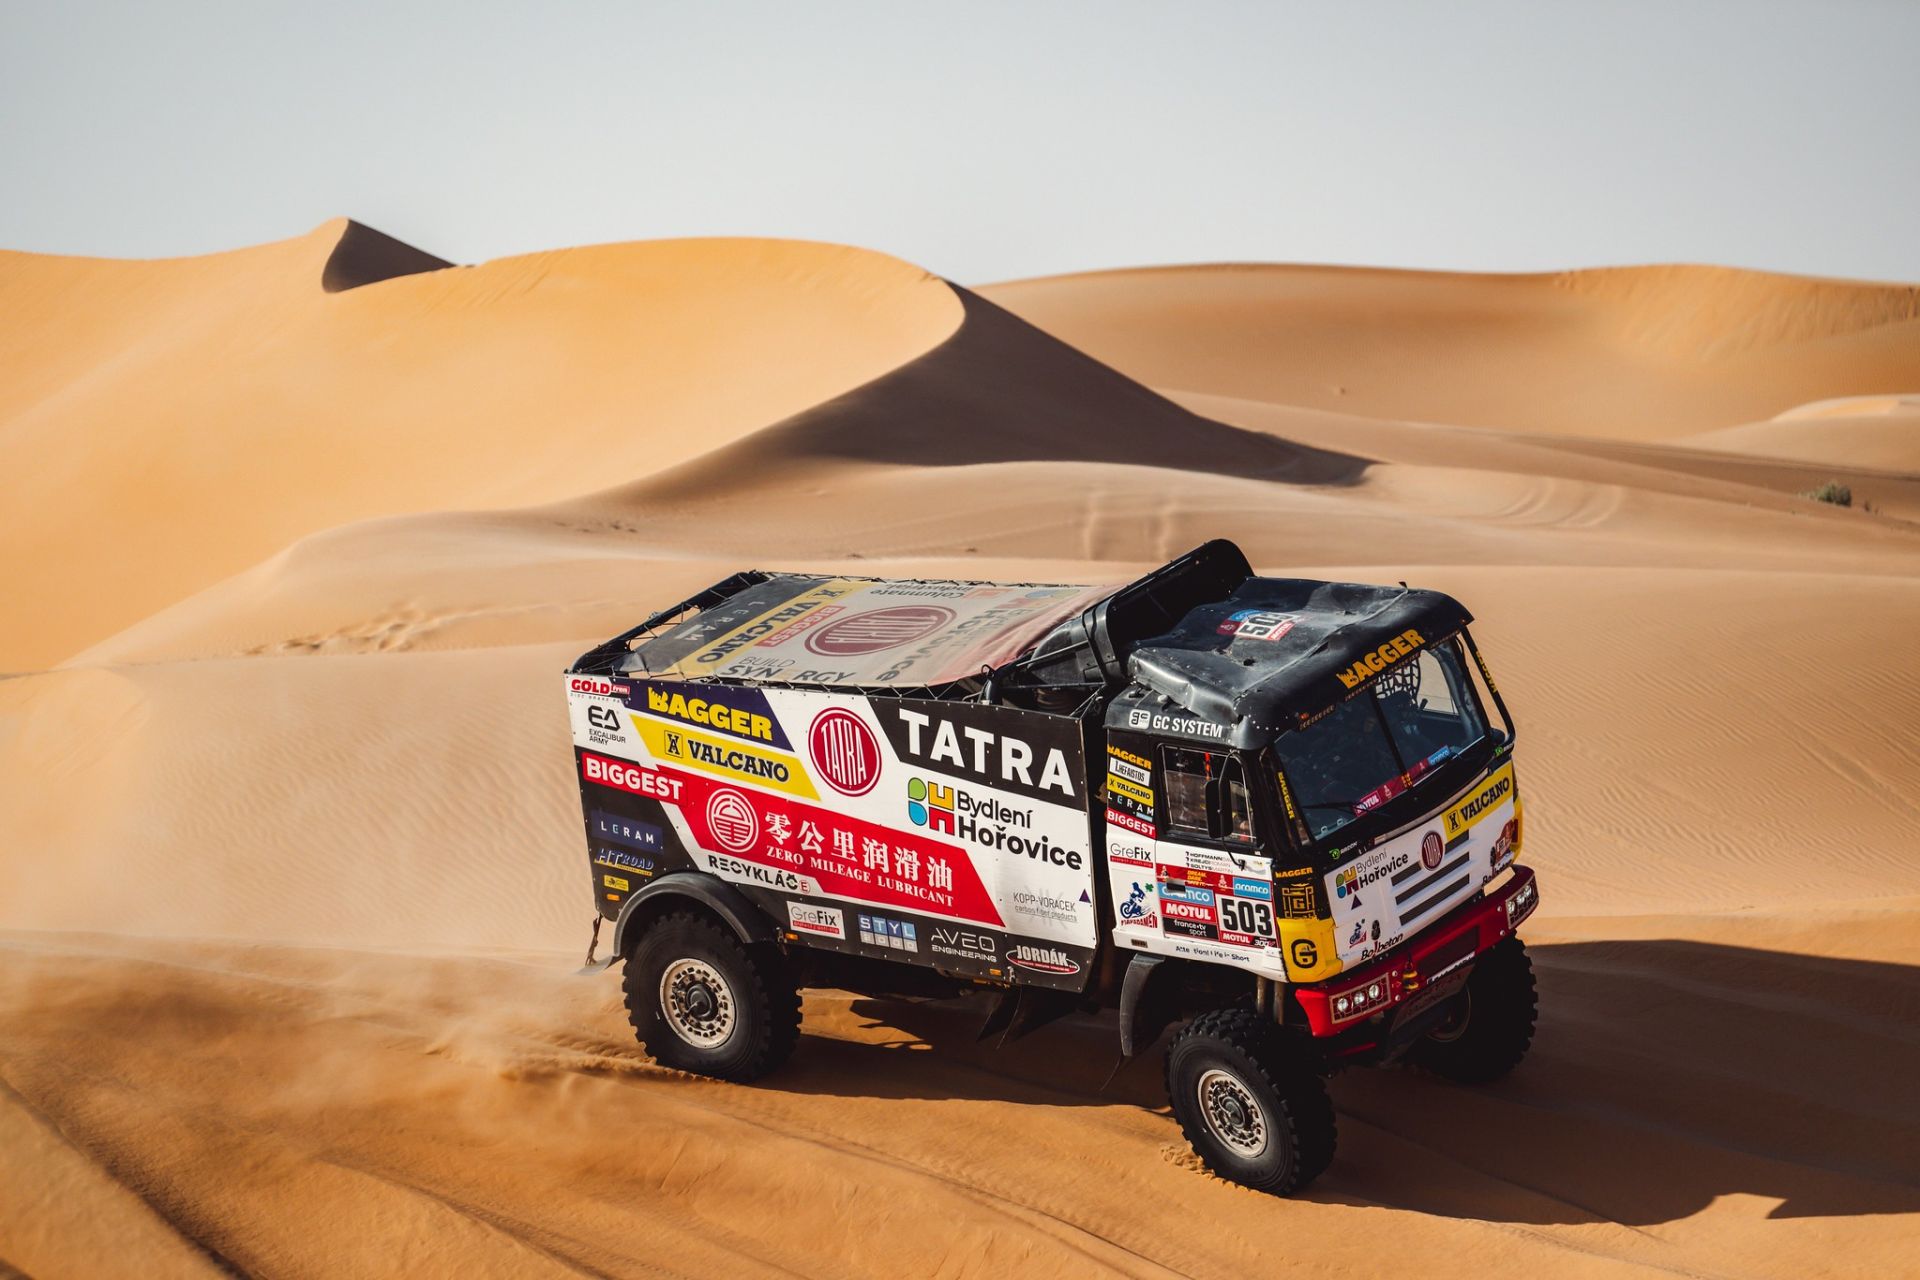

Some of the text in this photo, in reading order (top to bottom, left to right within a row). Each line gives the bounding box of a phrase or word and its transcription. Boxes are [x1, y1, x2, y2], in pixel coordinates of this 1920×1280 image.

[697, 601, 822, 663] VALCANO
[760, 606, 841, 645] BIGGEST
[739, 656, 796, 668] BUILD
[1336, 629, 1426, 689] BAGGER
[721, 664, 856, 683] SYNRGY
[571, 679, 610, 695] GOLD
[648, 687, 772, 741] BAGGER
[1152, 714, 1223, 738] GC SYSTEM
[589, 729, 626, 743] EXCALIBUR
[589, 736, 609, 746] ARMY
[688, 739, 790, 783] VALCANO
[820, 718, 868, 786] TATRA
[899, 707, 1076, 797] TATRA
[1107, 744, 1152, 770] BAGGER
[586, 757, 684, 800] BIGGEST
[1117, 782, 1151, 800] VALCANO
[957, 789, 1033, 829] Bydlení
[1107, 791, 1154, 817] LERAM
[1460, 777, 1510, 822] VALCANO
[601, 821, 654, 844] LERAM
[1107, 810, 1155, 836] BIGGEST
[765, 812, 954, 892] 零公里润滑油
[959, 815, 1082, 871] Hořovice
[1110, 843, 1151, 861] GreFix
[1275, 867, 1313, 879] BAGGER
[1356, 847, 1388, 874] Bydlení
[1358, 853, 1409, 890] Hořovice
[766, 845, 955, 907] ZERO MILEAGE LUBRICANT
[1234, 881, 1269, 895] aramco
[1161, 886, 1211, 902] amco
[790, 906, 838, 927] GreFix
[1166, 902, 1212, 921] MOTUL
[1221, 898, 1273, 936] 503
[860, 917, 914, 938] STYL
[931, 927, 996, 953] AVEO
[1188, 927, 1208, 938] sport
[1222, 933, 1251, 944] MOTUL
[931, 944, 998, 964] ENGINEERING
[1016, 944, 1069, 967] JORDÁK
